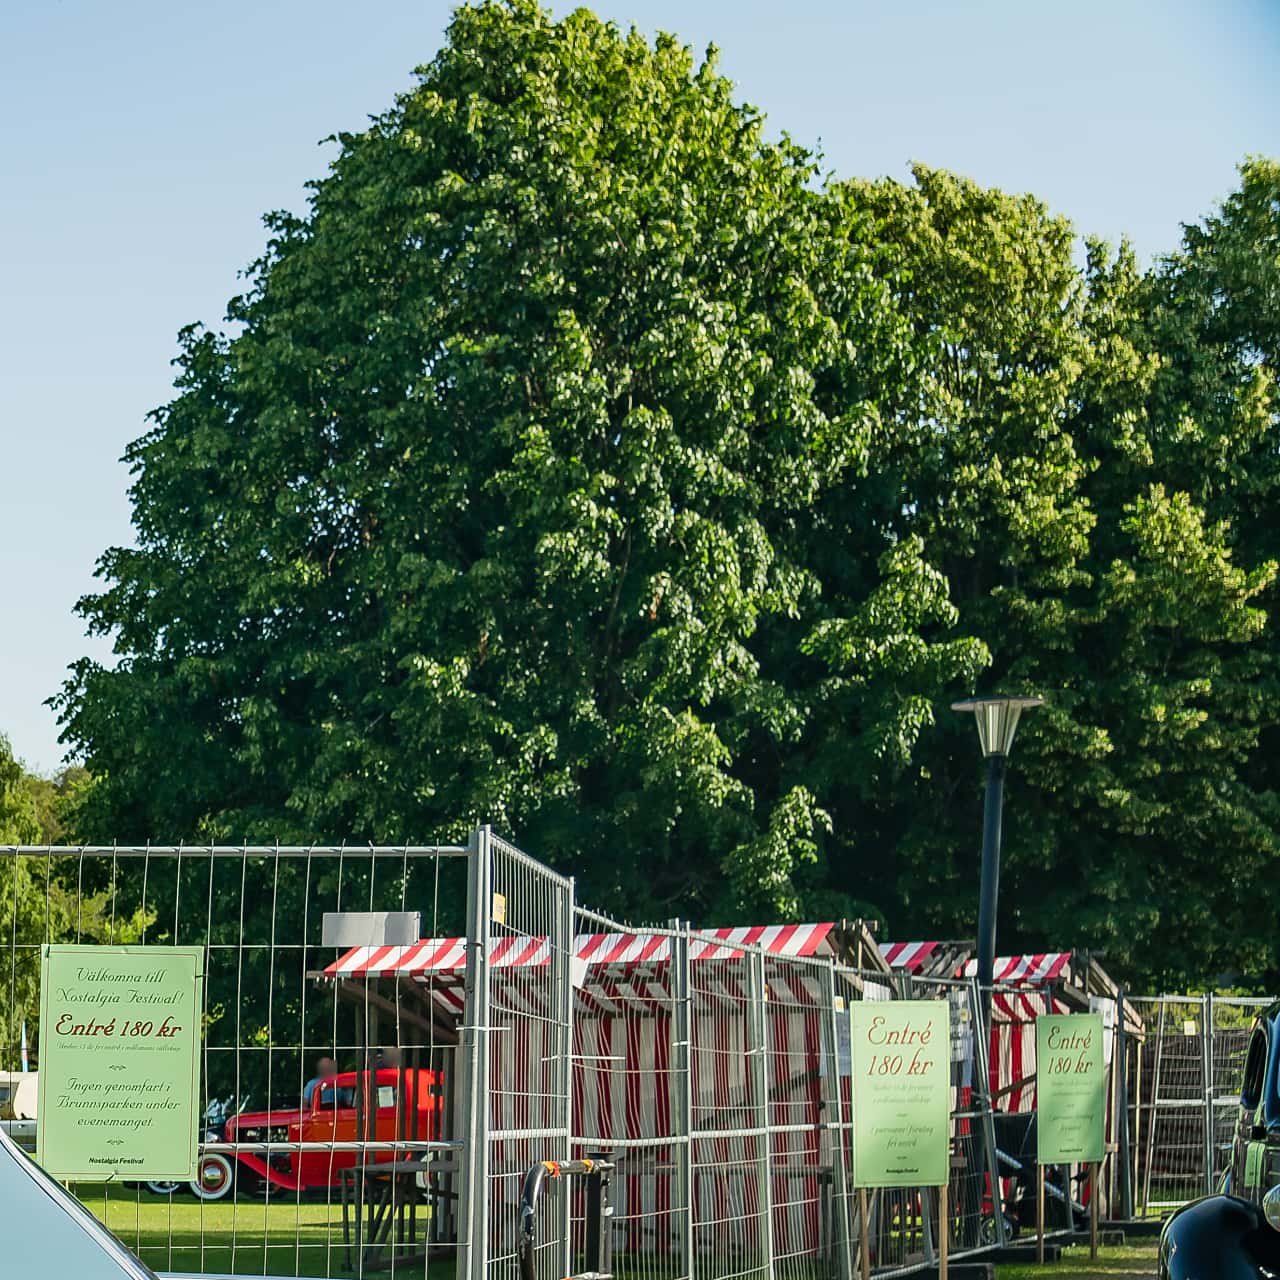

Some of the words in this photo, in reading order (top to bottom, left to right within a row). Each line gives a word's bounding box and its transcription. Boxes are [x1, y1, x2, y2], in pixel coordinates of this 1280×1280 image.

[76, 967, 141, 983] Välkomna
[145, 968, 168, 983] till
[56, 986, 121, 1007] Nostalgia
[127, 988, 185, 1005] Festival!
[55, 1013, 116, 1036] Entré
[120, 1020, 154, 1037] 180
[155, 1016, 182, 1038] kr
[868, 1016, 932, 1045] Entré
[1047, 1025, 1092, 1050] Entré
[867, 1055, 903, 1076] 180
[907, 1047, 934, 1076] kr
[1048, 1057, 1071, 1074] 180
[1074, 1050, 1093, 1074] kr
[65, 1077, 106, 1095] Ingen
[104, 1078, 163, 1096] genomfart
[56, 1095, 143, 1112] Brunnsparken
[145, 1097, 181, 1110] under
[89, 1157, 119, 1166] Nostalgia
[119, 1157, 144, 1165] Festival
